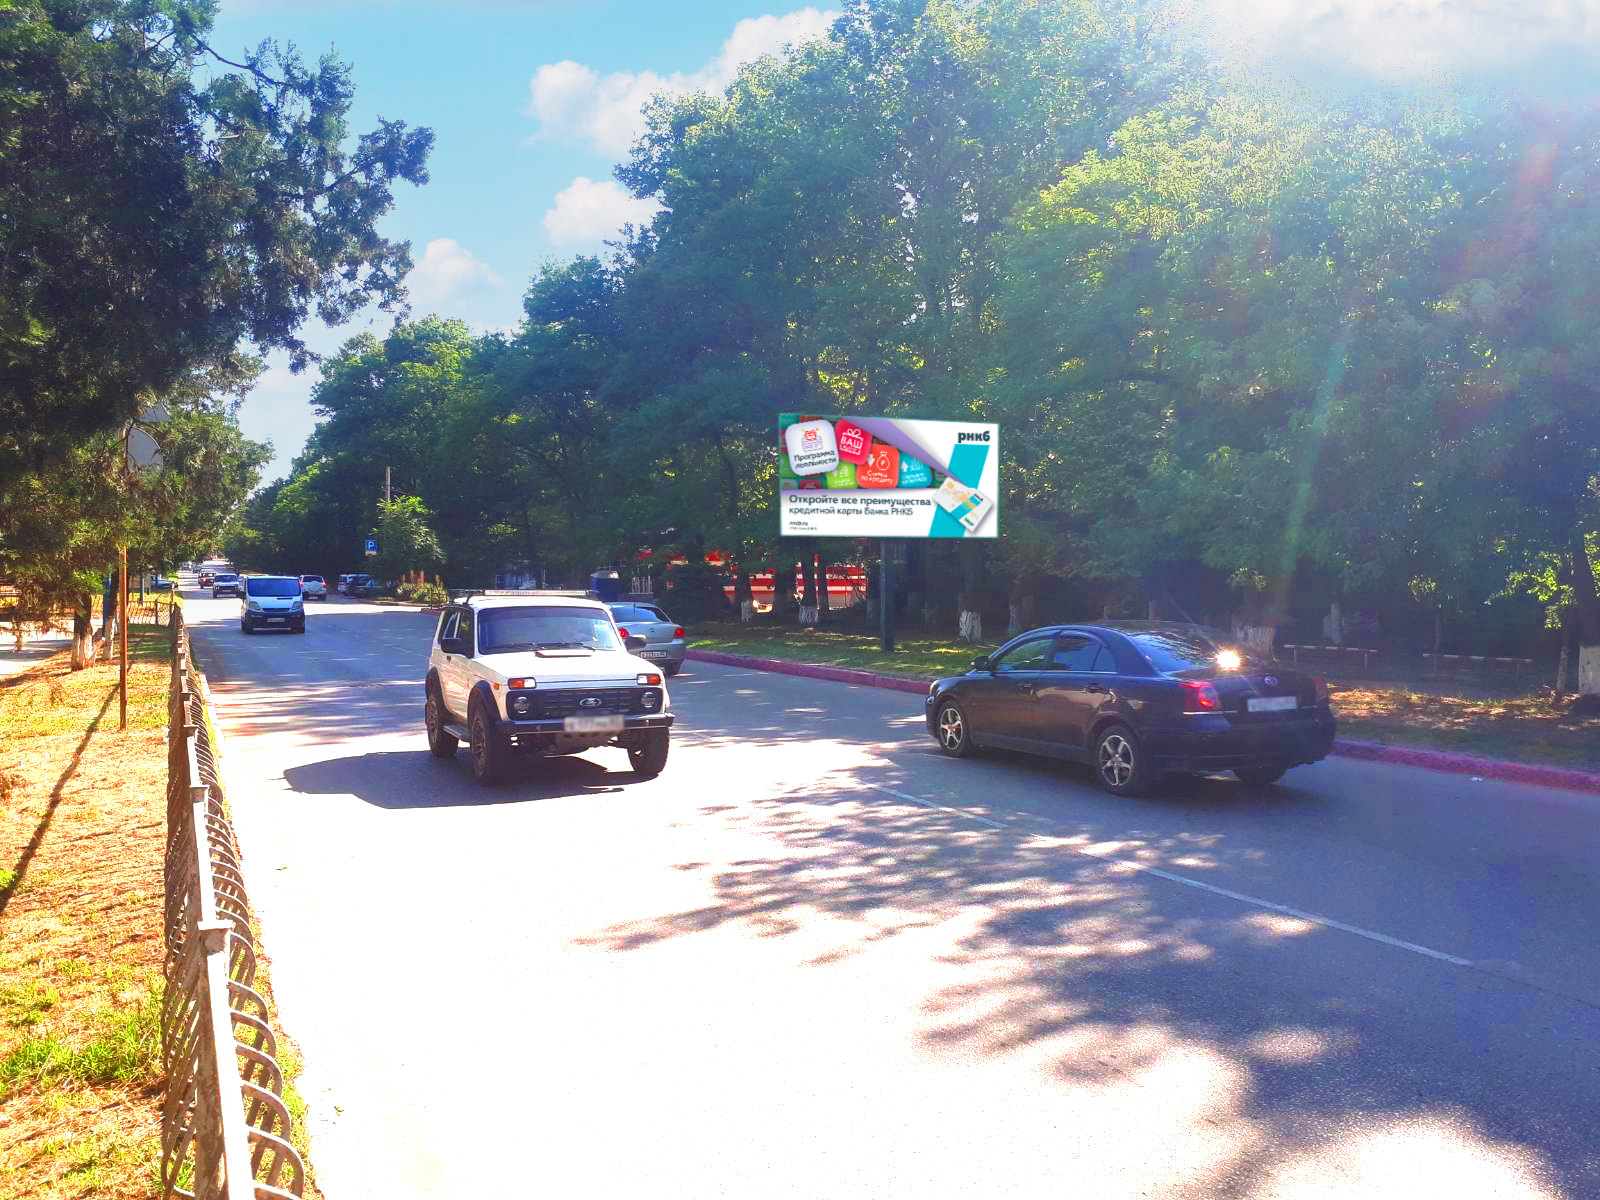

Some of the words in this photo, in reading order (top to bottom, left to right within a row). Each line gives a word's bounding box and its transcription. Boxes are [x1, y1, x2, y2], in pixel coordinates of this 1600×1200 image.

[958, 430, 990, 443] рнкб
[840, 436, 863, 450] ВАШ
[794, 450, 835, 462] Программа
[795, 457, 837, 469] лояльности
[789, 494, 839, 506] Откройте
[860, 497, 931, 507] преимущества
[789, 506, 835, 515] кредитной
[837, 508, 862, 516] карты
[864, 507, 889, 515] Банка
[891, 507, 913, 515] РНКБ
